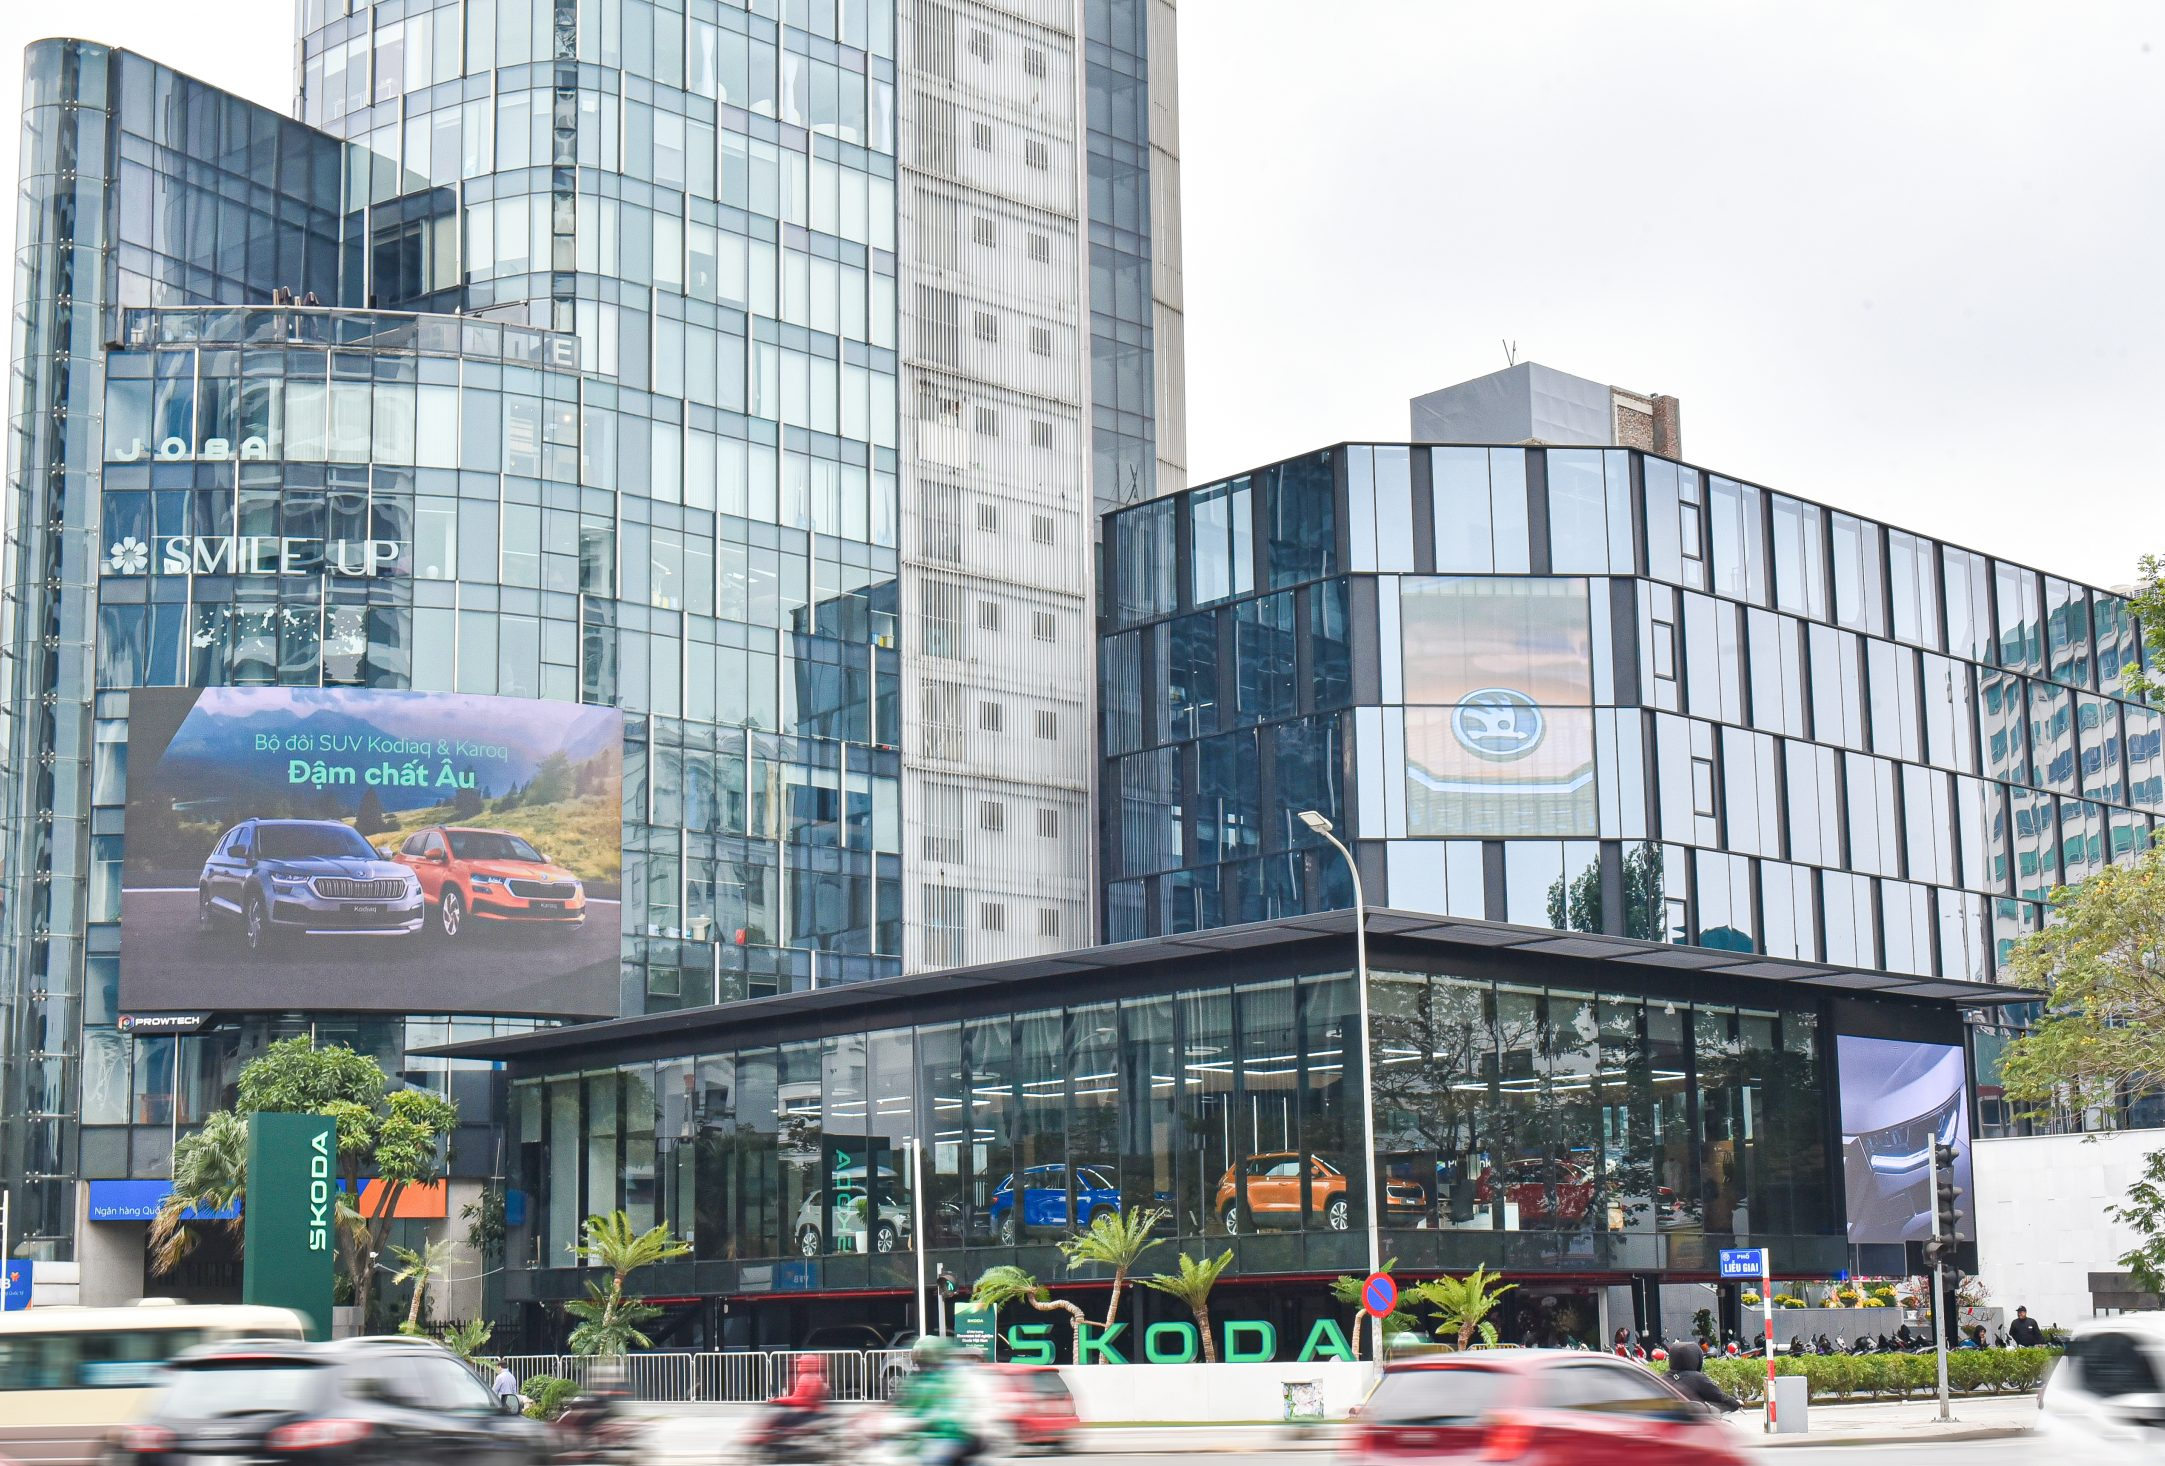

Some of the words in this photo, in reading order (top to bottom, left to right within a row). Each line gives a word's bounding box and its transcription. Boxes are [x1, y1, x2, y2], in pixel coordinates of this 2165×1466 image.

[115, 436, 266, 461] JOBA
[164, 536, 307, 575] SMILE
[337, 539, 399, 576] UP
[255, 734, 280, 754] Bộ
[285, 734, 314, 752] đôi
[320, 734, 362, 752] SUV
[368, 736, 431, 759] Kodiaq
[437, 739, 450, 755] &
[456, 739, 508, 762] Karoq
[288, 760, 356, 790] Đậm
[364, 759, 429, 787] chất
[435, 758, 475, 788] Âu
[354, 905, 377, 913] Kodiaq
[135, 1016, 199, 1026] PROWTECH
[94, 1206, 117, 1217] Ngân
[119, 1206, 141, 1217] hàng
[1736, 1252, 1750, 1260] PHỐ
[1742, 1262, 1759, 1273] GIAI
[1007, 1319, 1360, 1366] SKODA
